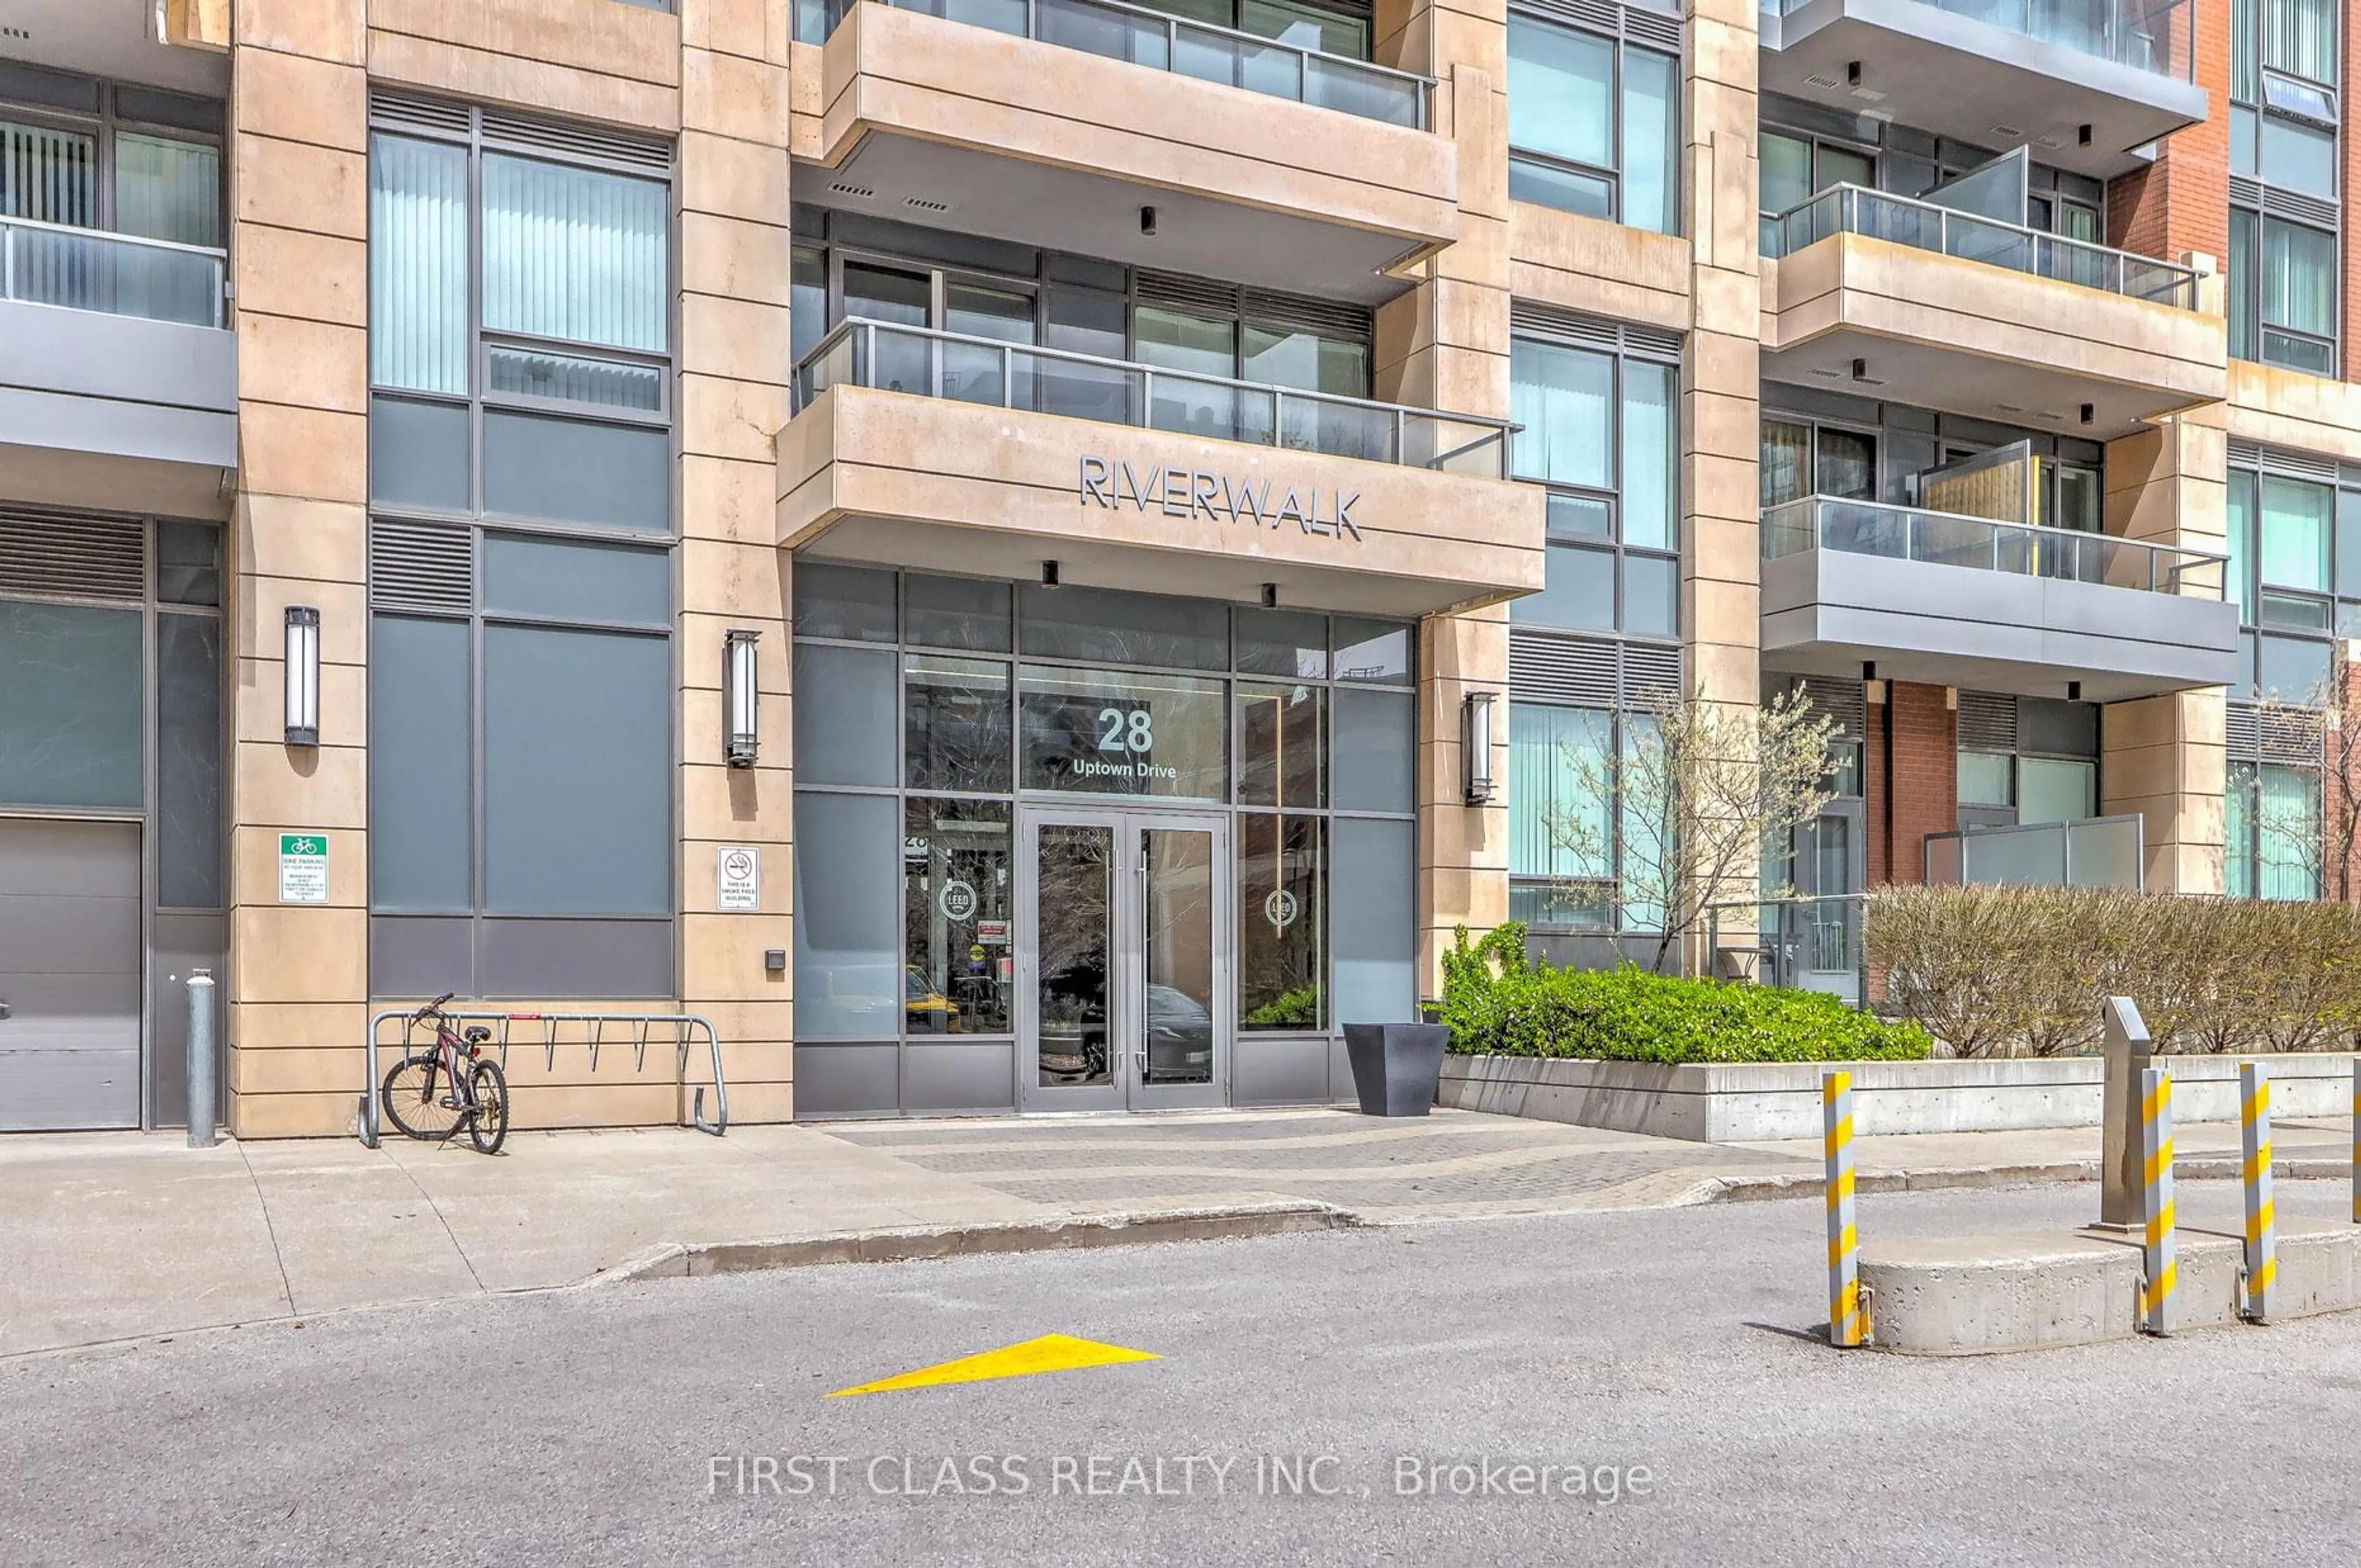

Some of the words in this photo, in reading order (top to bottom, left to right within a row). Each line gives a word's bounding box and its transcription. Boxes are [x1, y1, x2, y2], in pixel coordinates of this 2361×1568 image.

[1080, 454, 1361, 542] RIVERWALK
[1098, 708, 1153, 752] 28
[1074, 759, 1132, 778] Uptown
[1137, 763, 1176, 778] Drive
[948, 895, 968, 905] LEED
